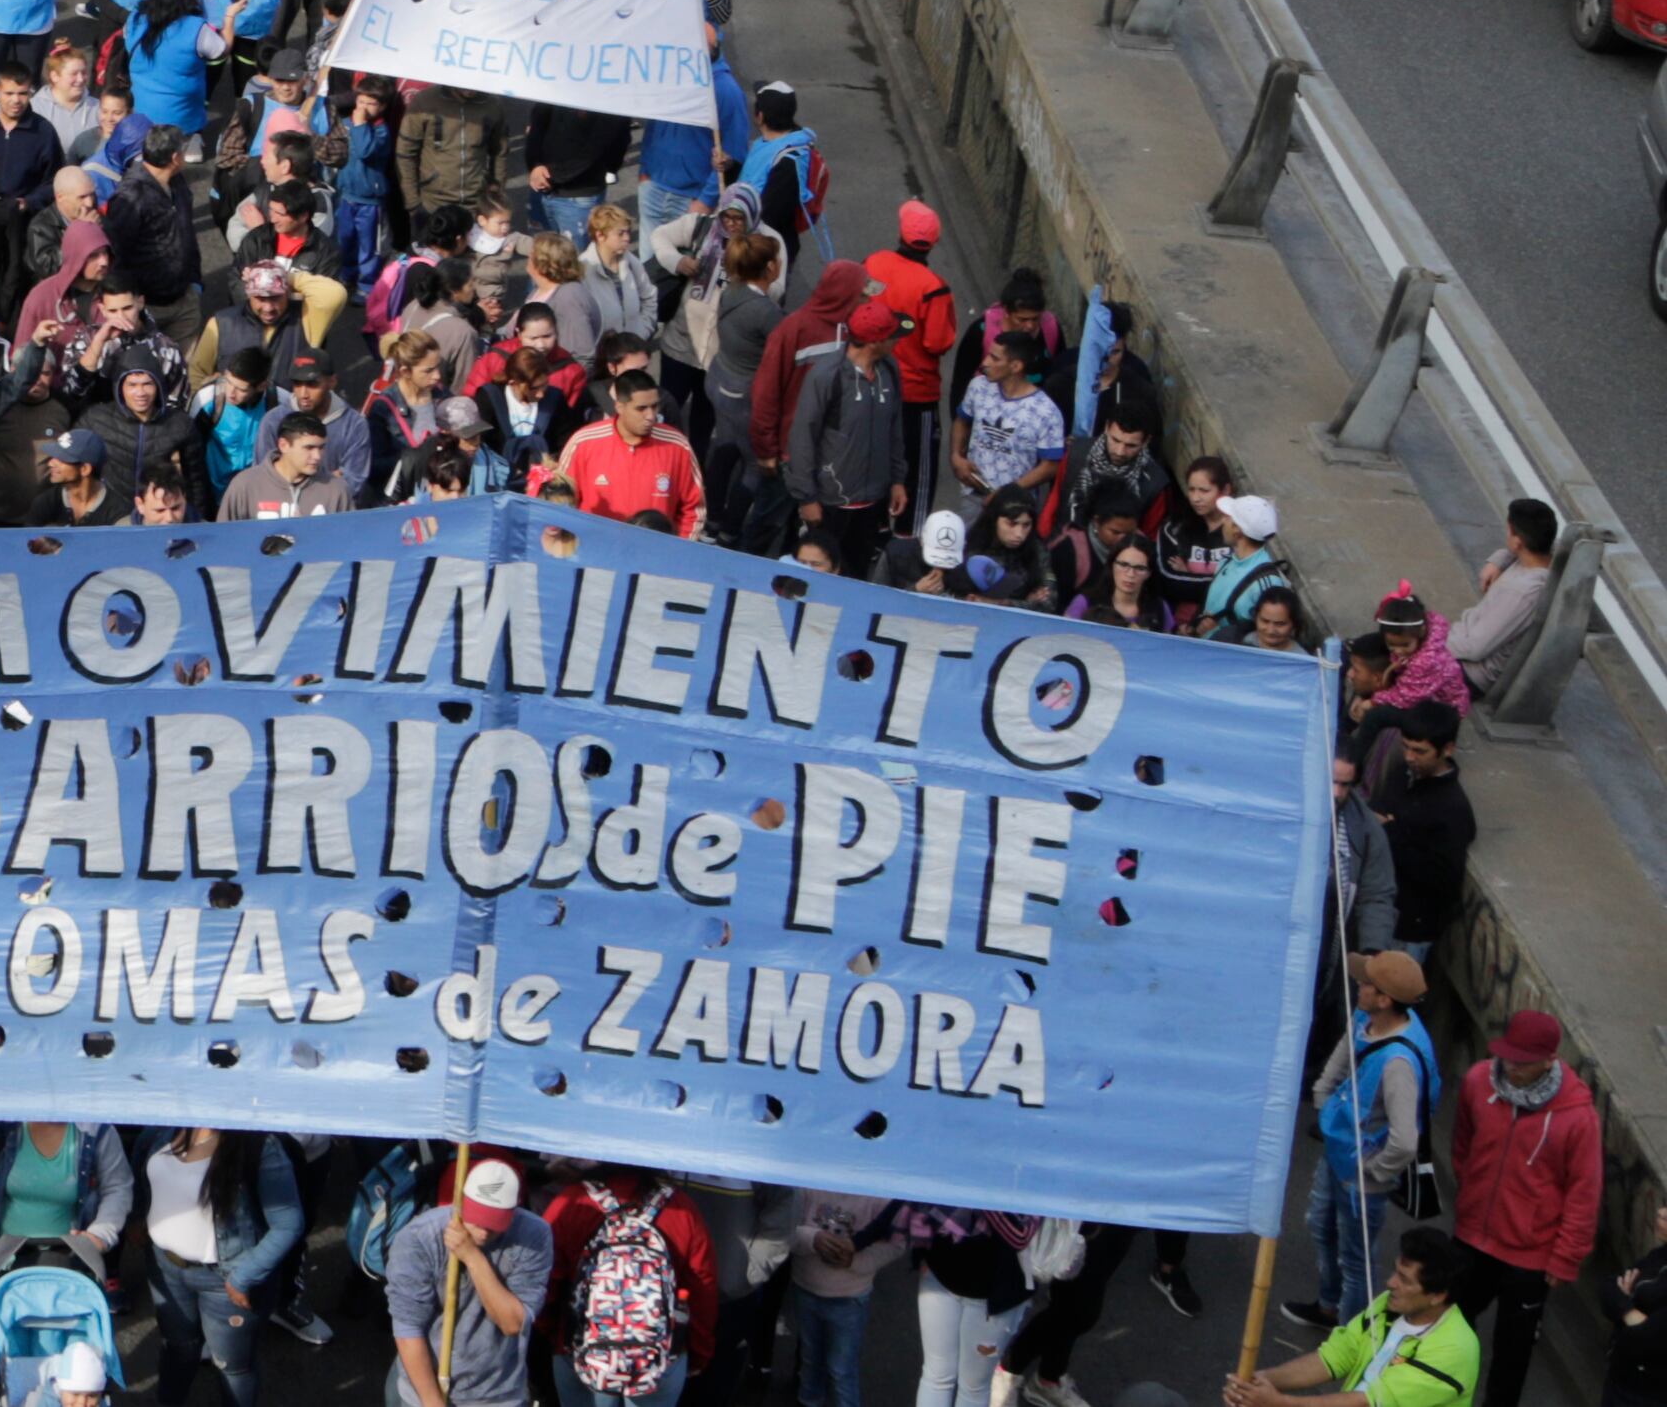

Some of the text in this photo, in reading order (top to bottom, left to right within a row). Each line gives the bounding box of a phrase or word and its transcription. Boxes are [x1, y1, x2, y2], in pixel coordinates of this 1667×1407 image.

[361, 3, 711, 87] EL REENCUENTRO
[588, 763, 743, 906] de
[784, 762, 1074, 965] PIE
[435, 943, 562, 1045] de
[582, 944, 1046, 1107] ZAMORA
